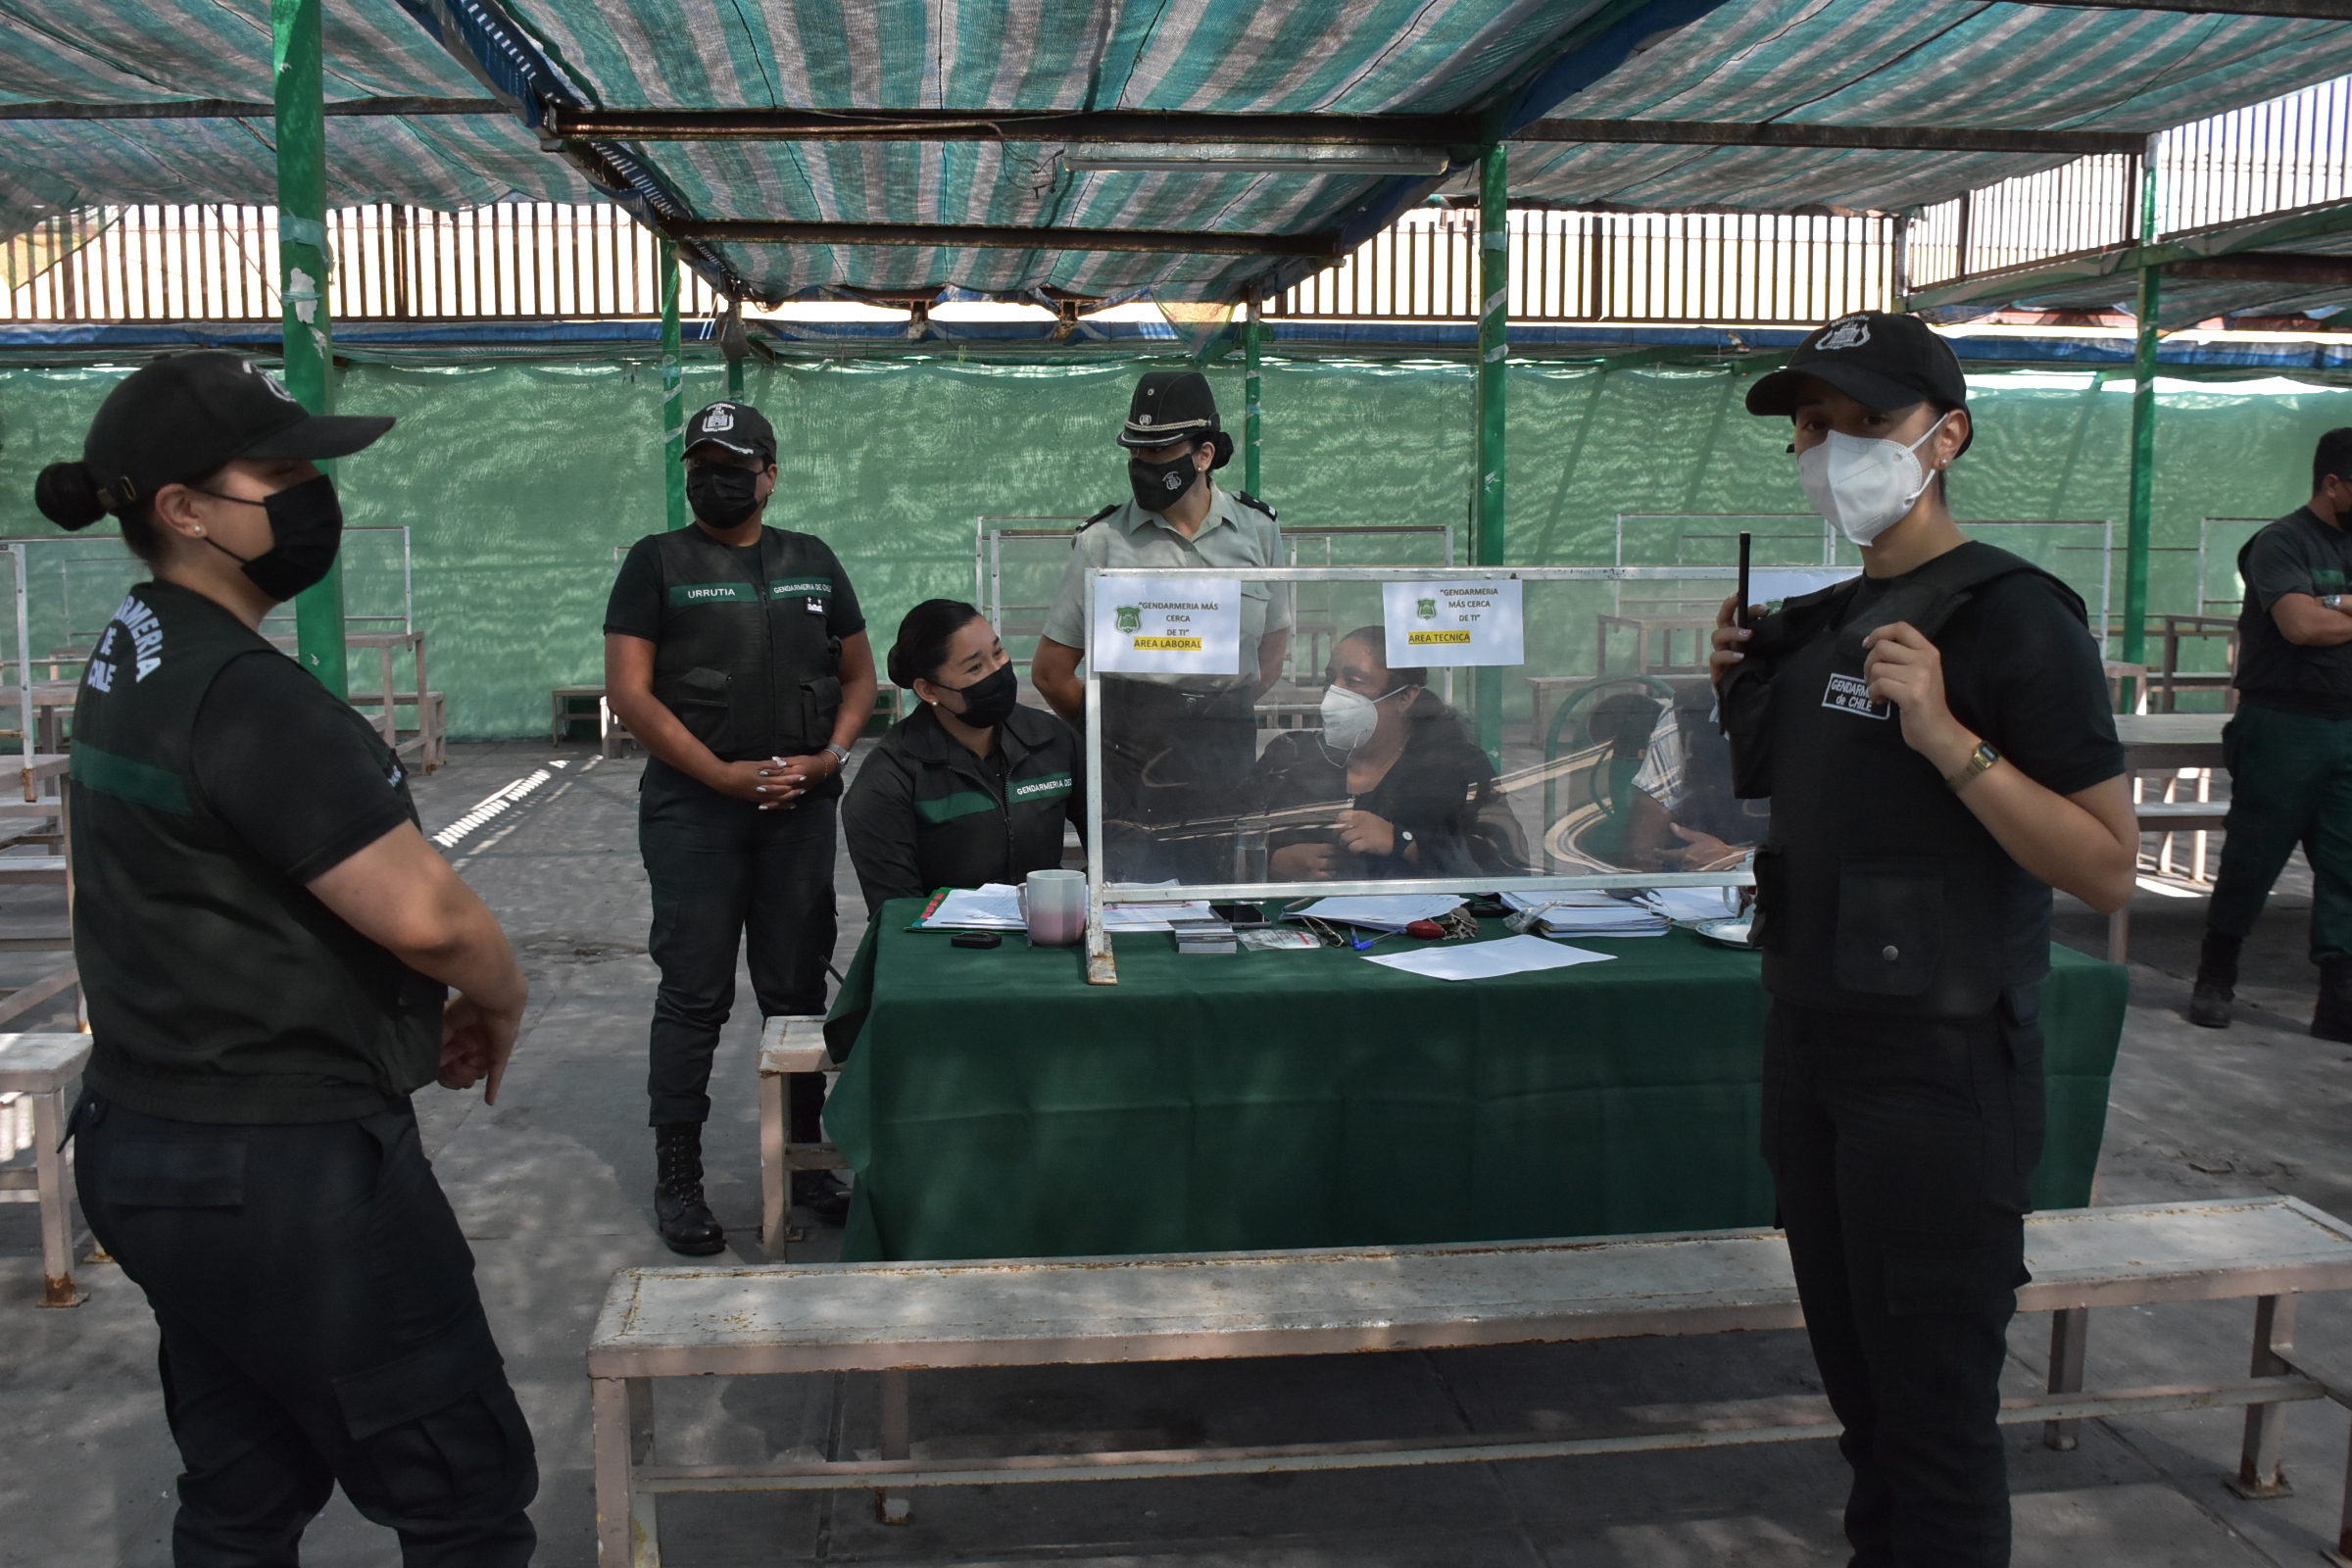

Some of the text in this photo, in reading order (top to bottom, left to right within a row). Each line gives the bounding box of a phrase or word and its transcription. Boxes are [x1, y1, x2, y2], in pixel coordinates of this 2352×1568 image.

[687, 588, 736, 599] URRUTIA
[773, 583, 815, 594] GENDARMERIA
[1200, 602, 1219, 611] MÁS
[1448, 600, 1465, 609] MÁS
[1408, 633, 1471, 643] AREA TECNICA
[1134, 639, 1201, 649] AREA LABORAL
[1831, 679, 1870, 699] GENDARM
[1836, 693, 1873, 712] de CHILE
[1016, 779, 1063, 795] GENDARMERIA
